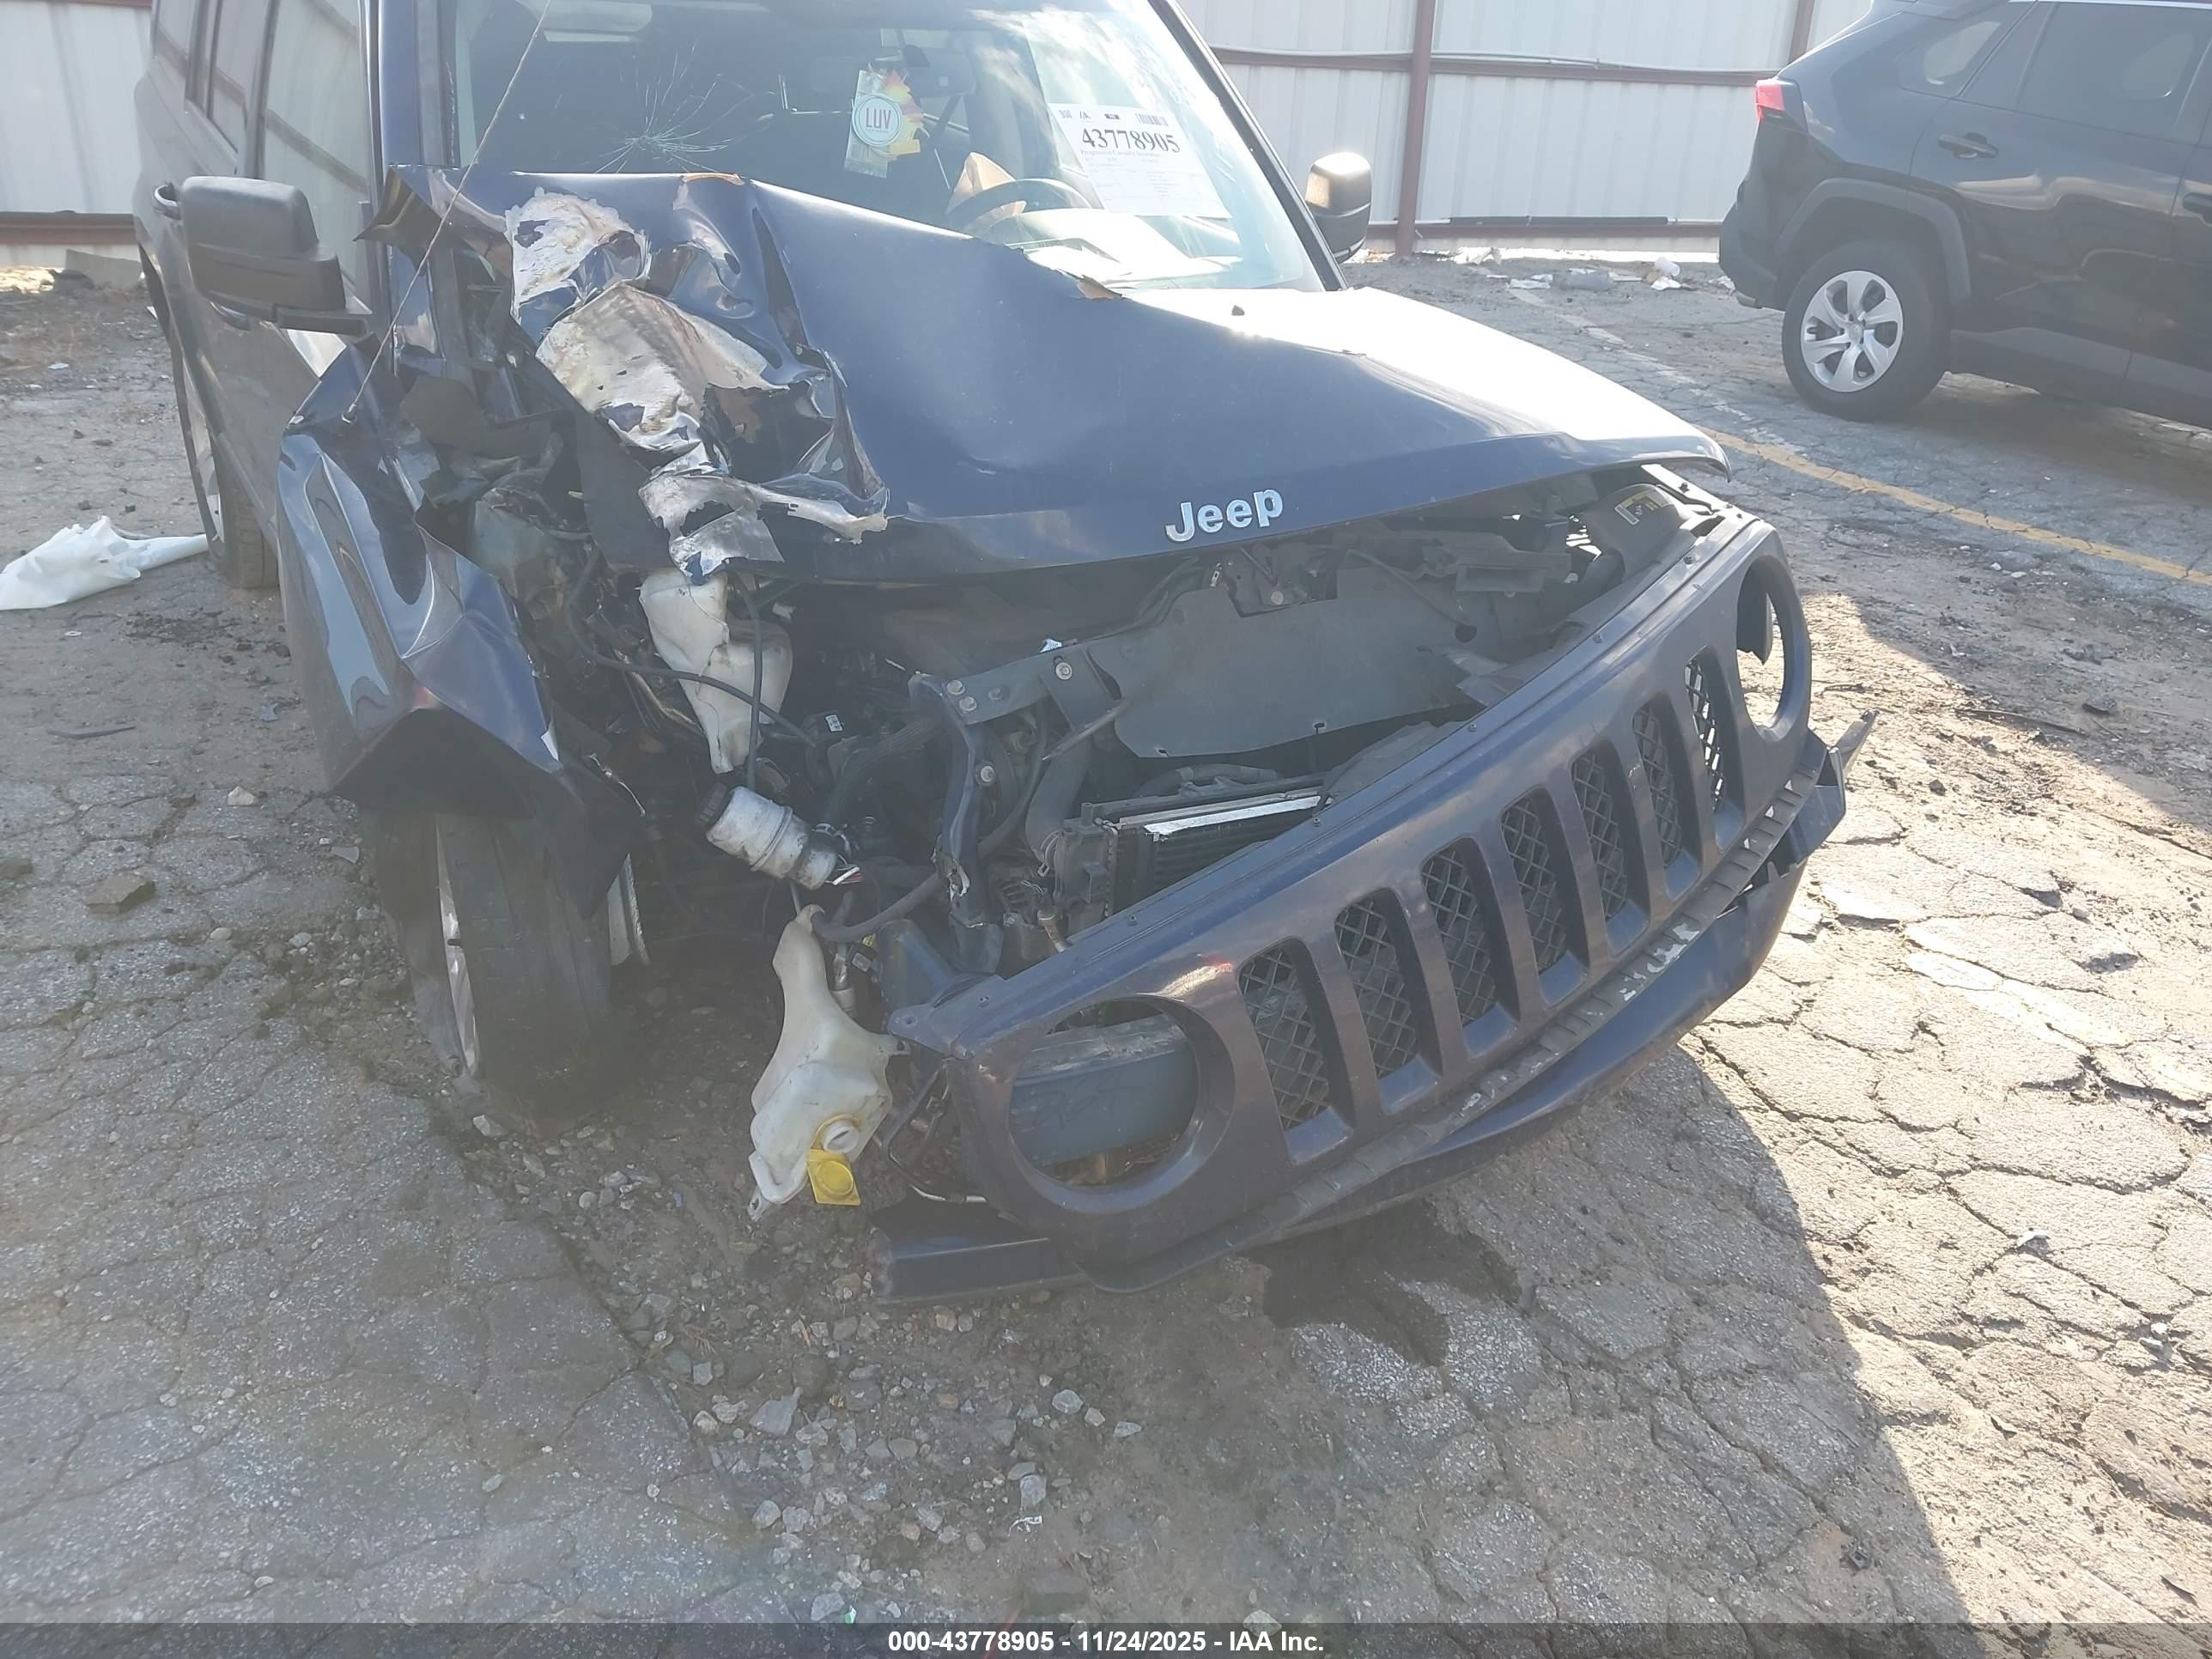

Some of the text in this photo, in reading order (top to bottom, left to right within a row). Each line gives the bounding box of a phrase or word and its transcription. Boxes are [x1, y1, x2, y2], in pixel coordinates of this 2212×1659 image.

[866, 108, 891, 130] LUV
[1082, 127, 1181, 153] 43778905
[1164, 489, 1284, 543] Jeep
